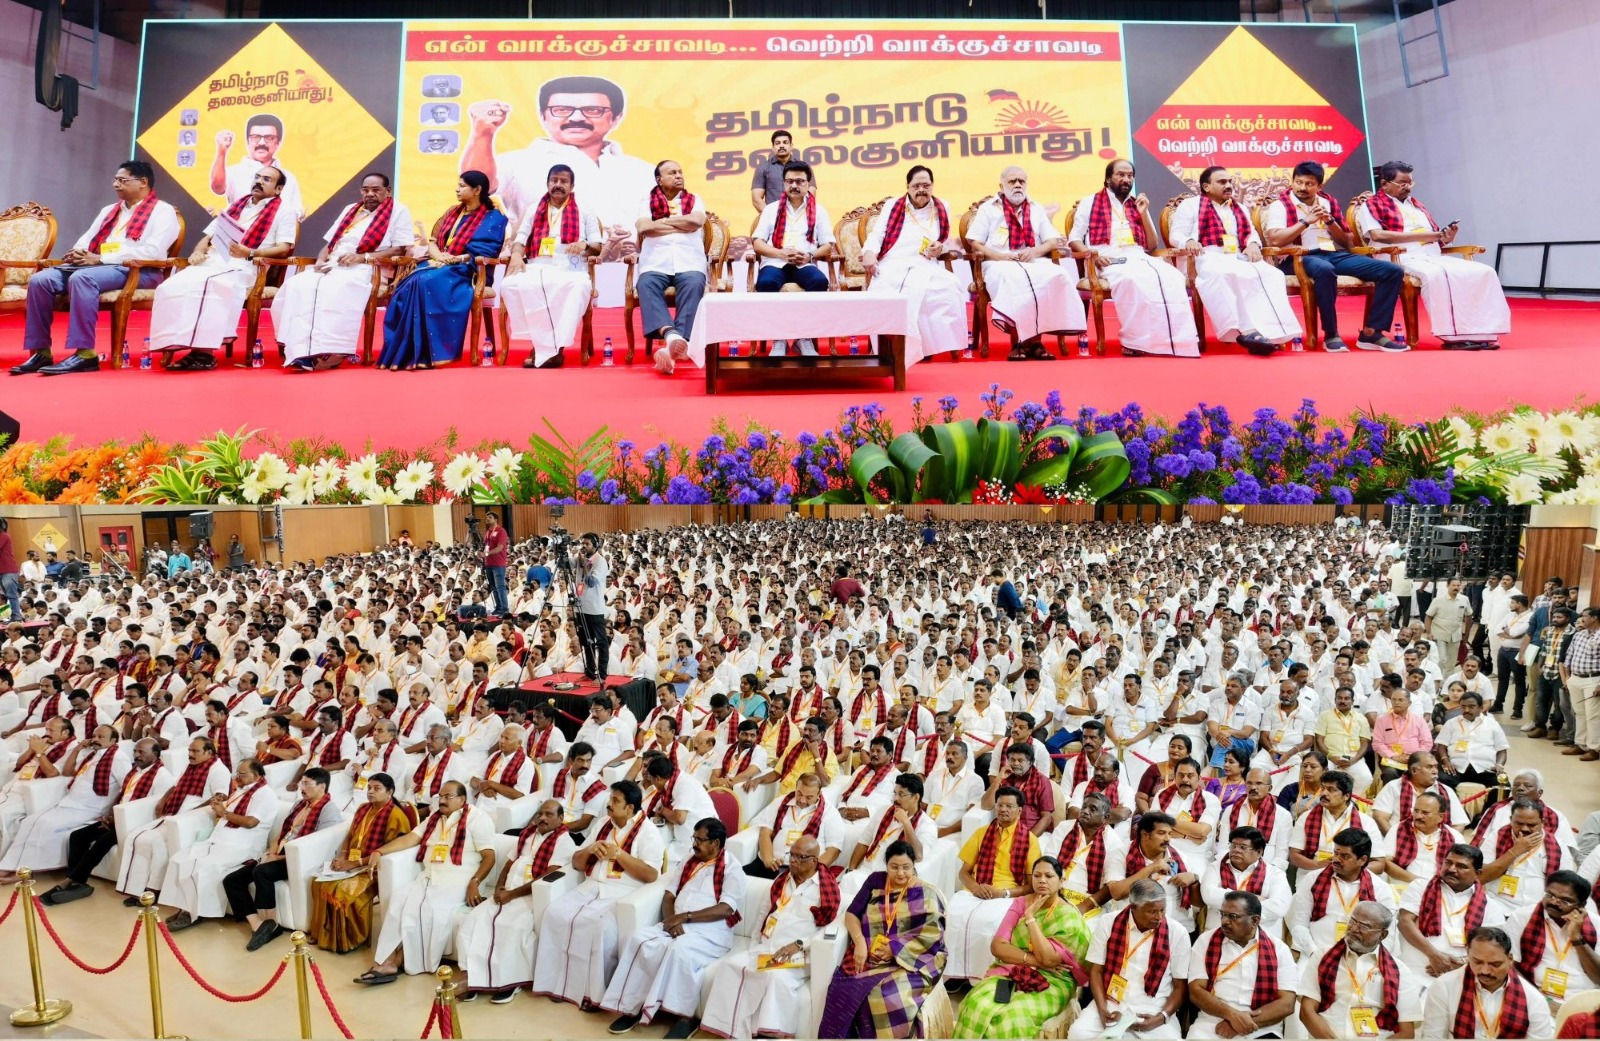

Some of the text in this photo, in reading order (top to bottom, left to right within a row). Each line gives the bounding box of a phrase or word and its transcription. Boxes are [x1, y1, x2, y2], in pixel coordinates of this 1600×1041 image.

[425, 33, 1104, 58] என் வாக்குச்சாவடி... வெற்றி வாக்குச்சாவடி
[209, 70, 289, 95] தமிழ்நாடு
[207, 86, 334, 112] தலைகுனியாது!
[705, 93, 968, 143] தமிழ்நாடு
[1156, 113, 1333, 133] என் வாக்குச்சாவடி...
[1158, 135, 1343, 157] வெற்றி வாக்குச்சாவடி
